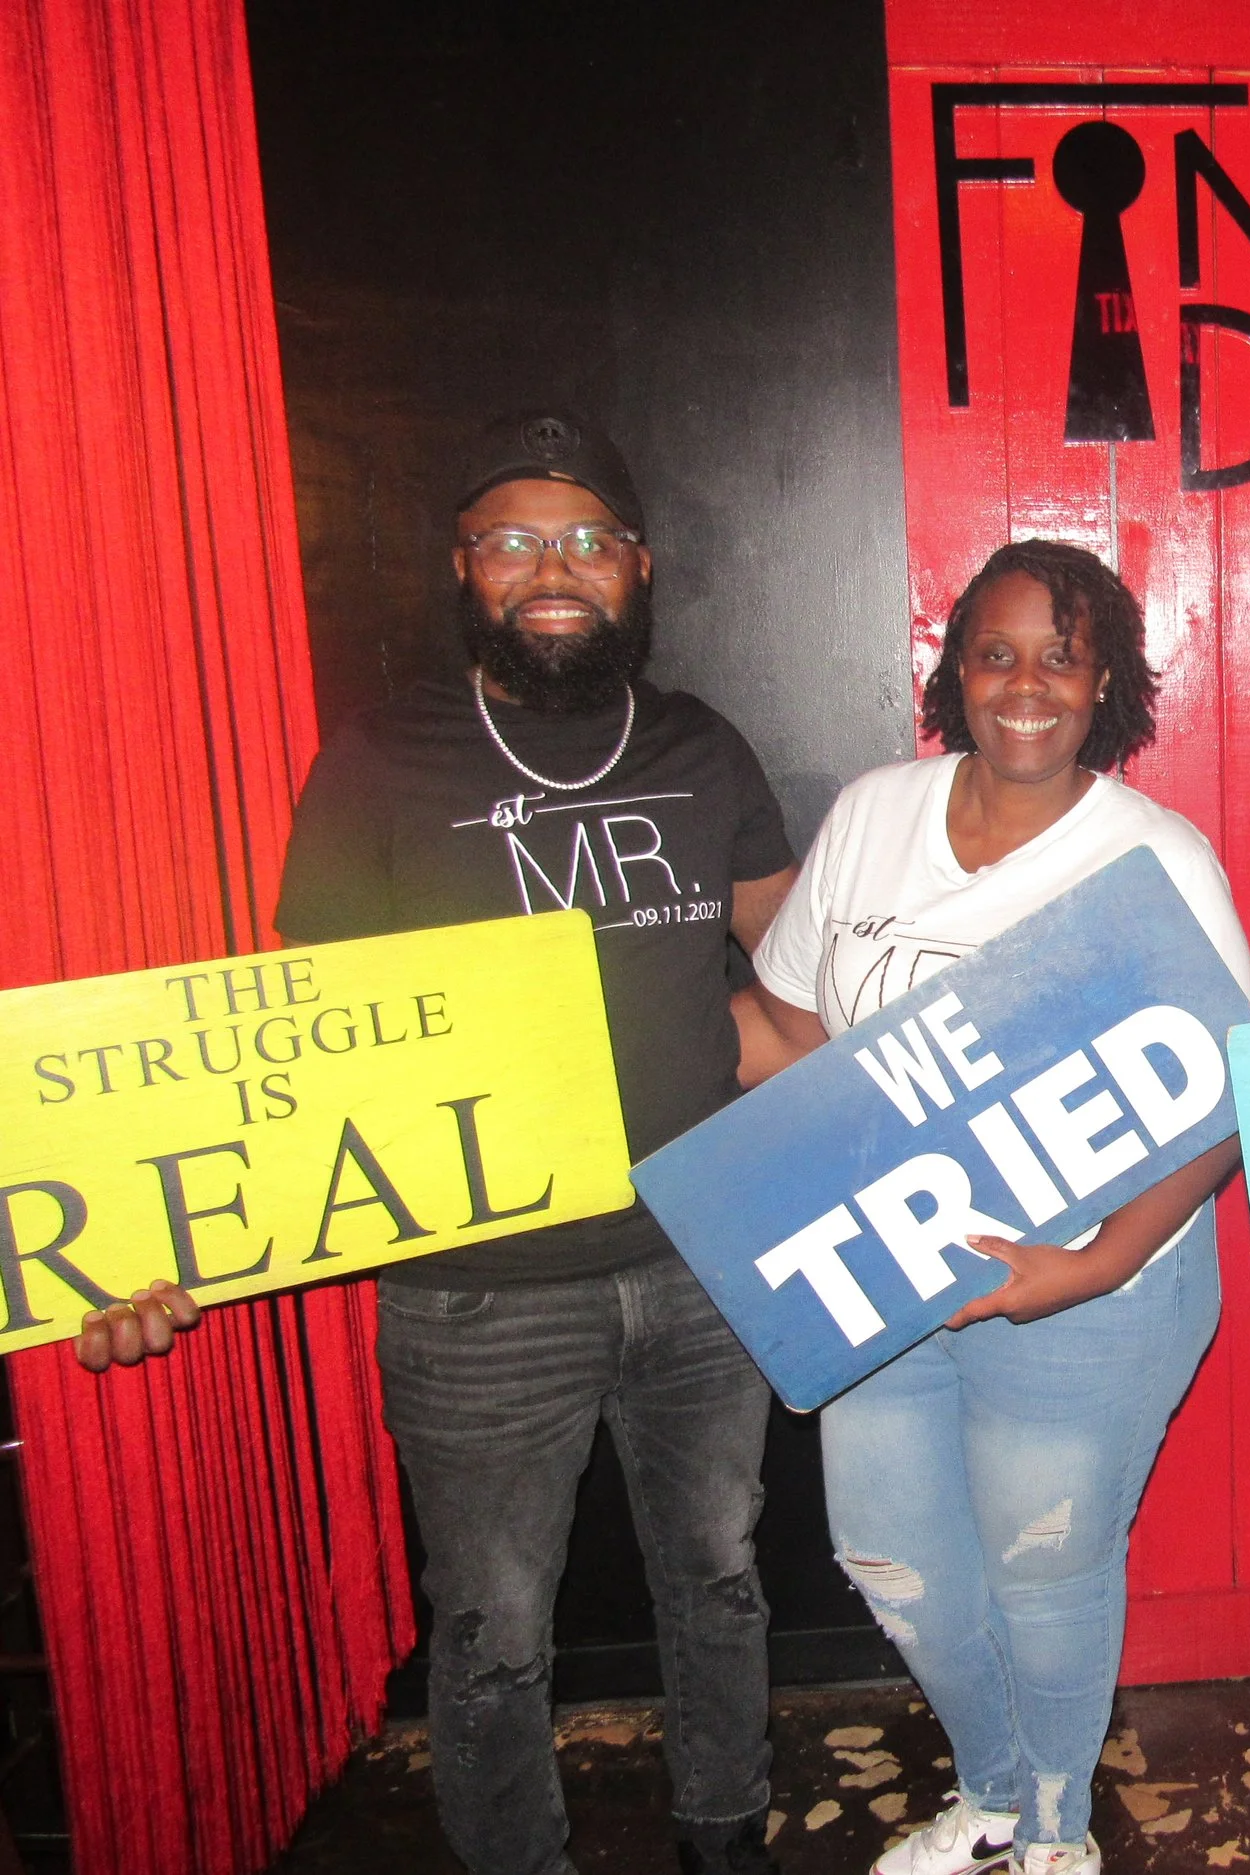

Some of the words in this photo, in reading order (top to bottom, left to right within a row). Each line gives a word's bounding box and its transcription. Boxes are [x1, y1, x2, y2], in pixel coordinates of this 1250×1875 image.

[488, 794, 545, 828] est
[507, 815, 701, 916] MR.
[632, 901, 723, 928] 09.11.2021
[852, 915, 915, 942] est
[165, 957, 321, 1023] THE
[33, 992, 454, 1105] STRUGGLE
[853, 991, 1006, 1129] WE
[232, 1072, 299, 1126] IS
[0, 1093, 554, 1334] REAL
[753, 1004, 1226, 1349] TRIED
